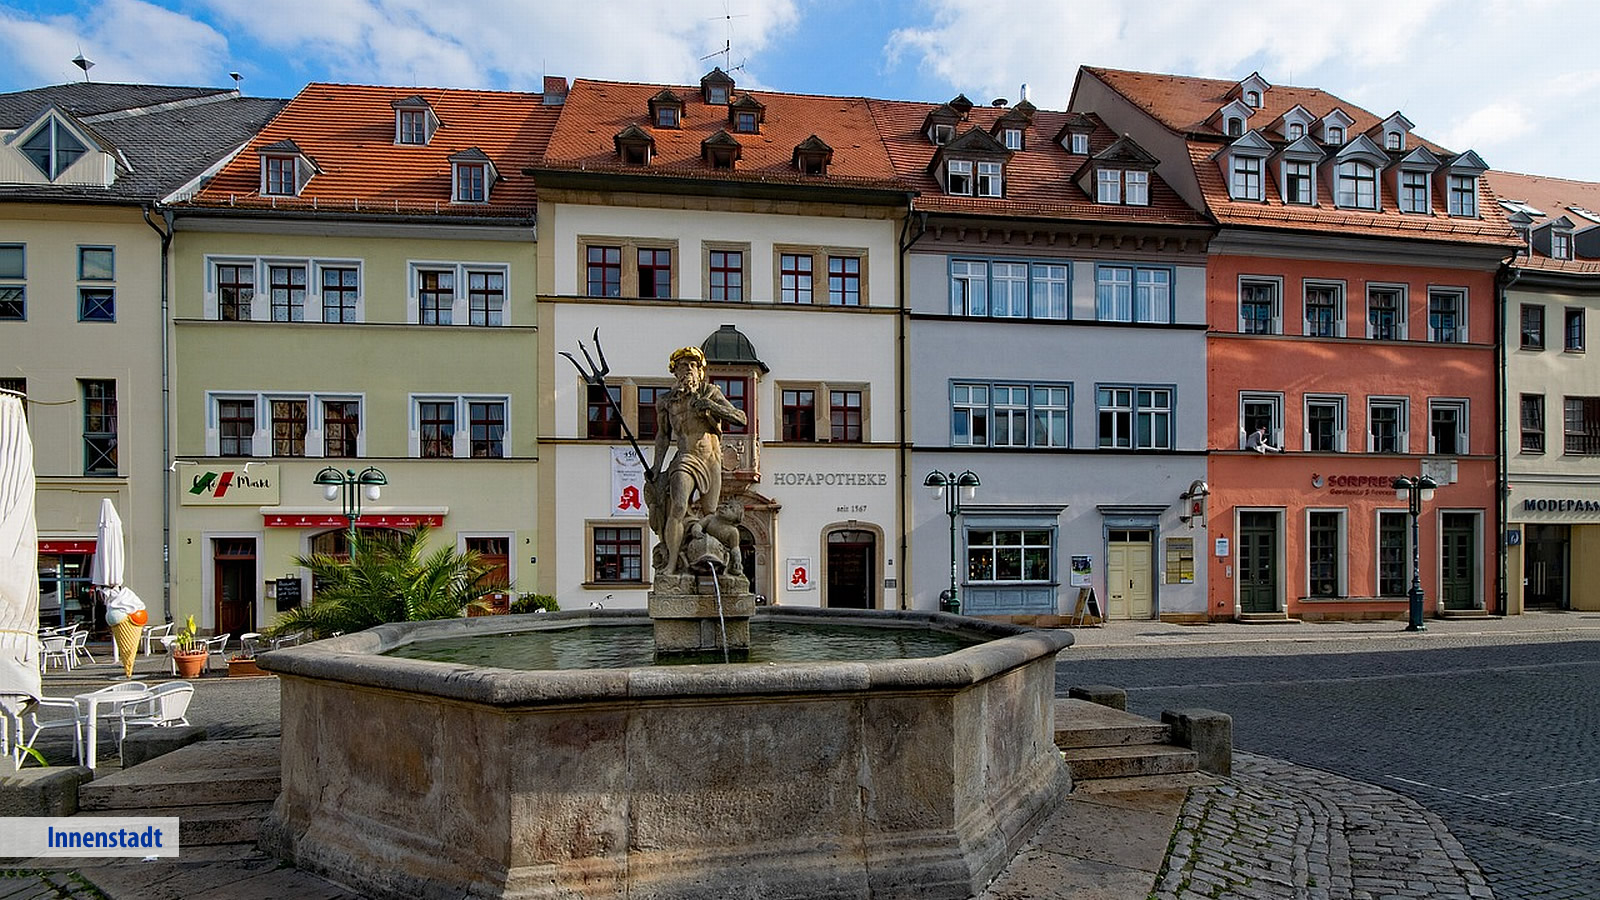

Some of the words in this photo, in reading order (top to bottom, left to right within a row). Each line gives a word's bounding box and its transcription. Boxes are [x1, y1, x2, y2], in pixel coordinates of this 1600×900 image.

[773, 473, 888, 486] HOFAPOTHEKE
[836, 505, 849, 513] seit
[851, 505, 868, 513] 1567
